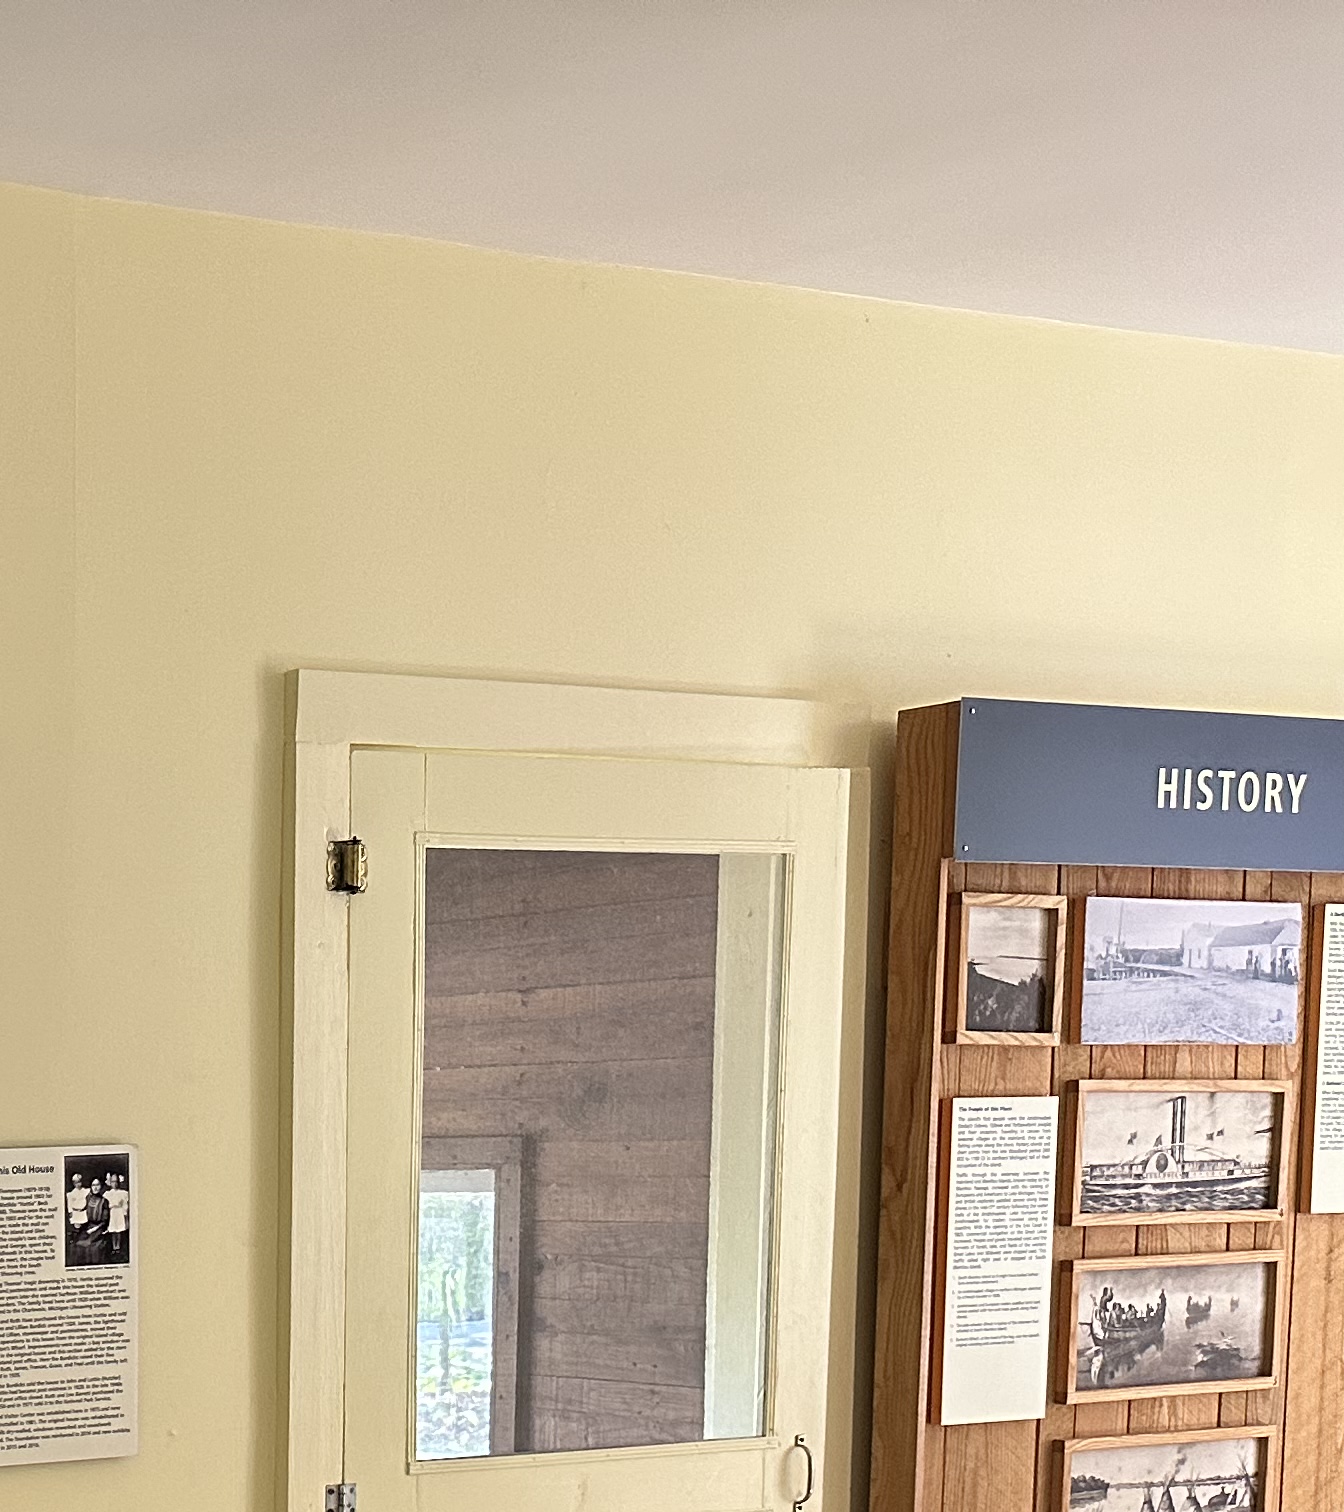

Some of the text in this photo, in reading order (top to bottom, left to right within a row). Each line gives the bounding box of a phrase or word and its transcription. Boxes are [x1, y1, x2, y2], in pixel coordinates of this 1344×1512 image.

[1157, 767, 1308, 814] HISTORY
[11, 1165, 26, 1174] Old
[28, 1164, 53, 1173] House
